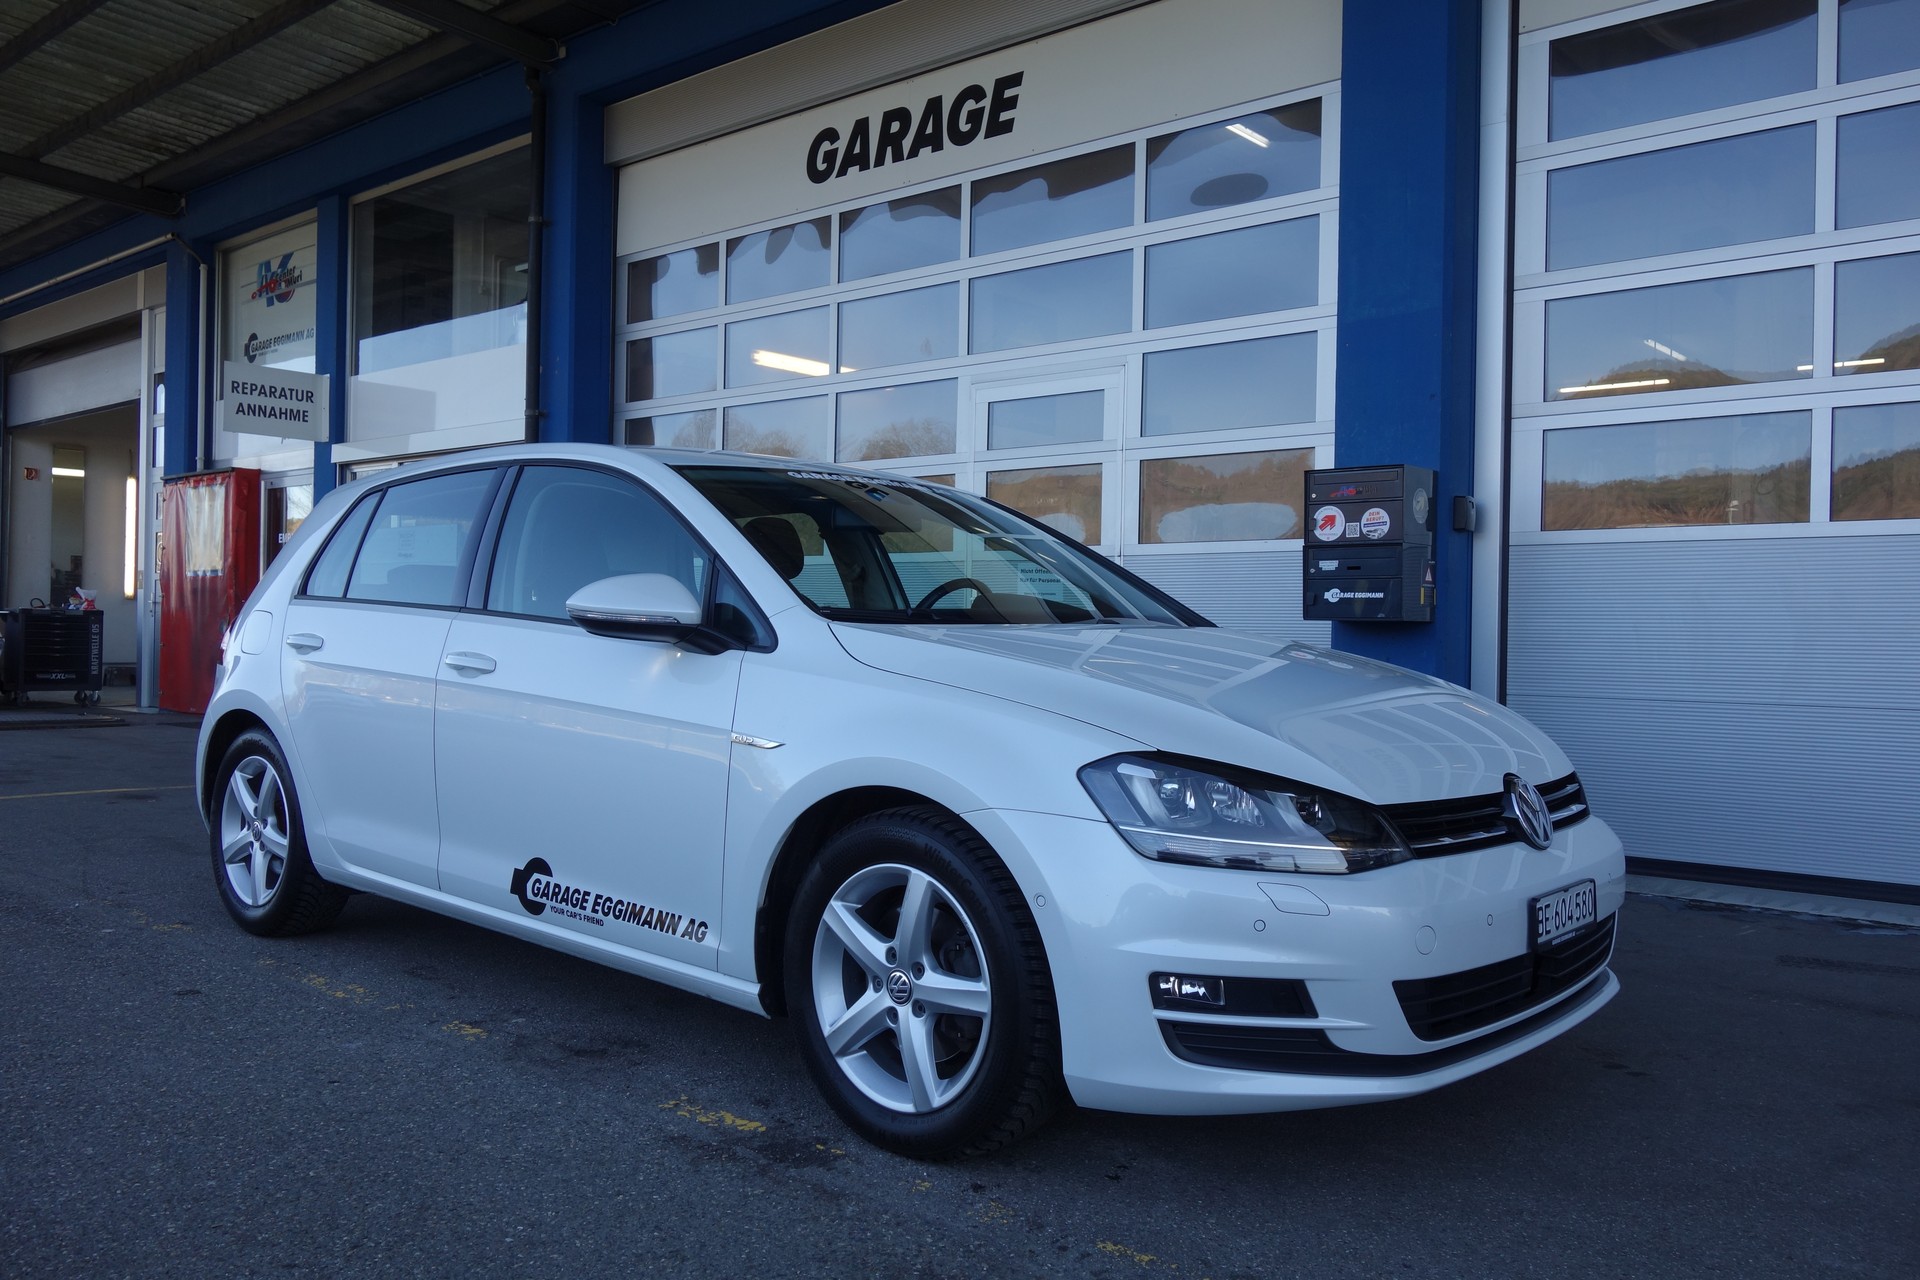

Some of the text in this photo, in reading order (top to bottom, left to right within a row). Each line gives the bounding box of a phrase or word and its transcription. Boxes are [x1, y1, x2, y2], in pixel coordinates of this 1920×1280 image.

[806, 70, 1024, 184] GARAGE
[250, 337, 274, 353] GARAGE
[273, 330, 305, 346] EGGIMANN
[305, 327, 314, 340] AG
[231, 380, 314, 404] REPARATUR
[235, 402, 309, 423] ANNAHME
[1332, 591, 1355, 599] GARAGE
[91, 634, 100, 675] KRAFTWELLE
[50, 672, 67, 680] XXL
[531, 878, 709, 943] GARAGE EGGIMANN AG
[549, 904, 605, 927] YOUR CAR'S FRIEND
